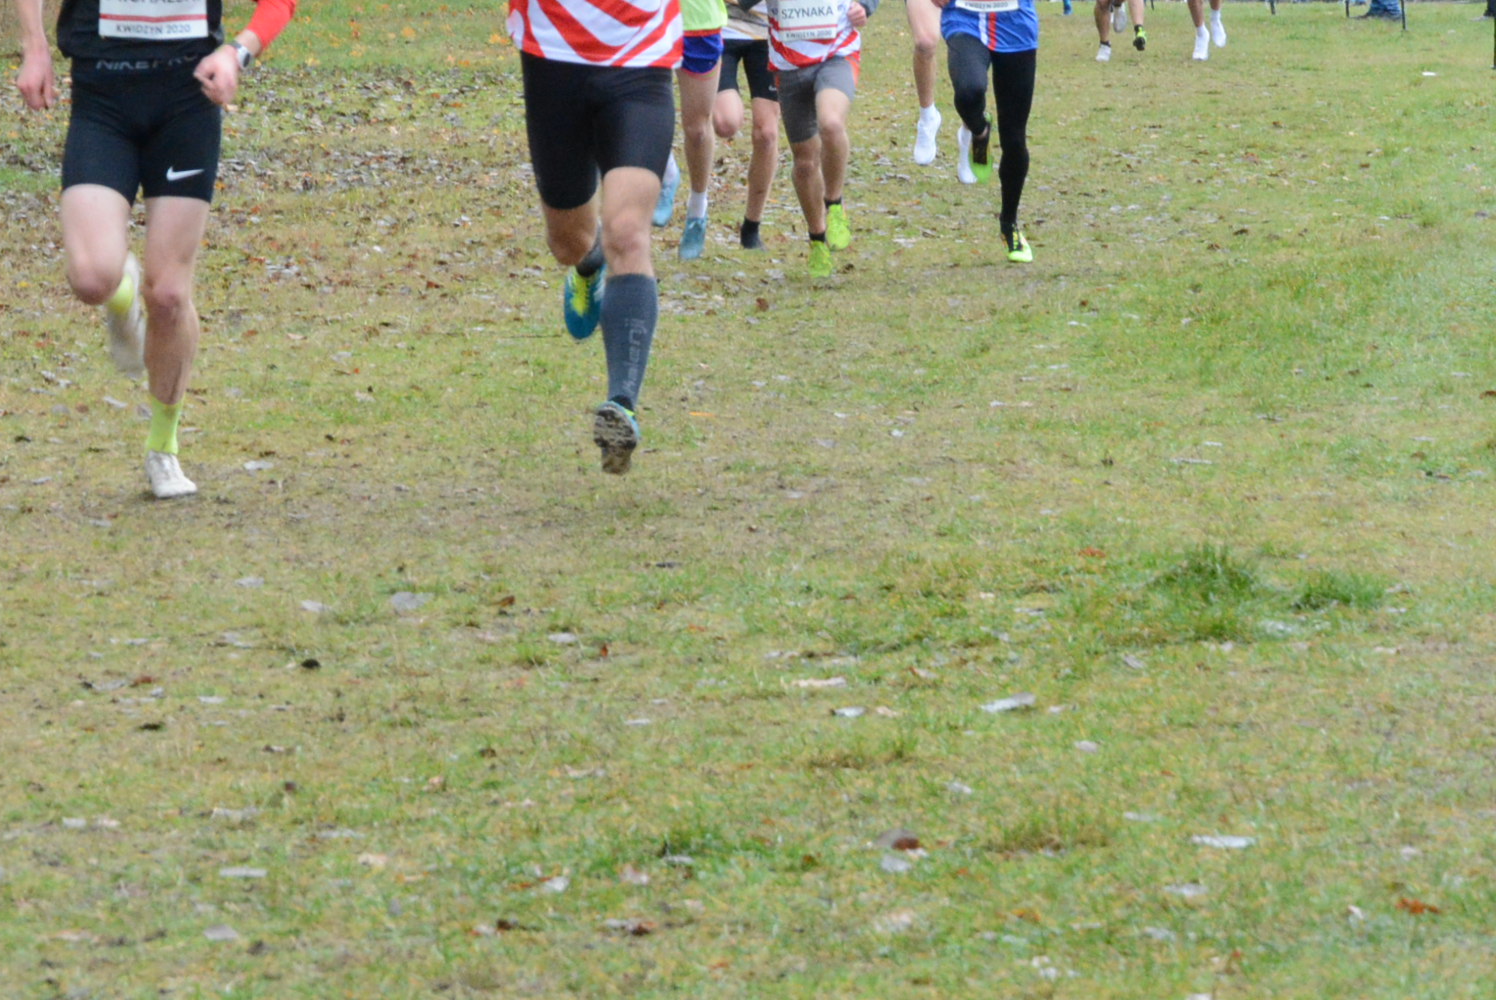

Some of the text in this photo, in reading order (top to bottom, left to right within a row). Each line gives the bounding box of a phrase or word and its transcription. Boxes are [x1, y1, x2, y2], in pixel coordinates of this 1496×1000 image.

[781, 6, 834, 19] SZYNAKA
[116, 24, 192, 34] KWIDZYN 2020
